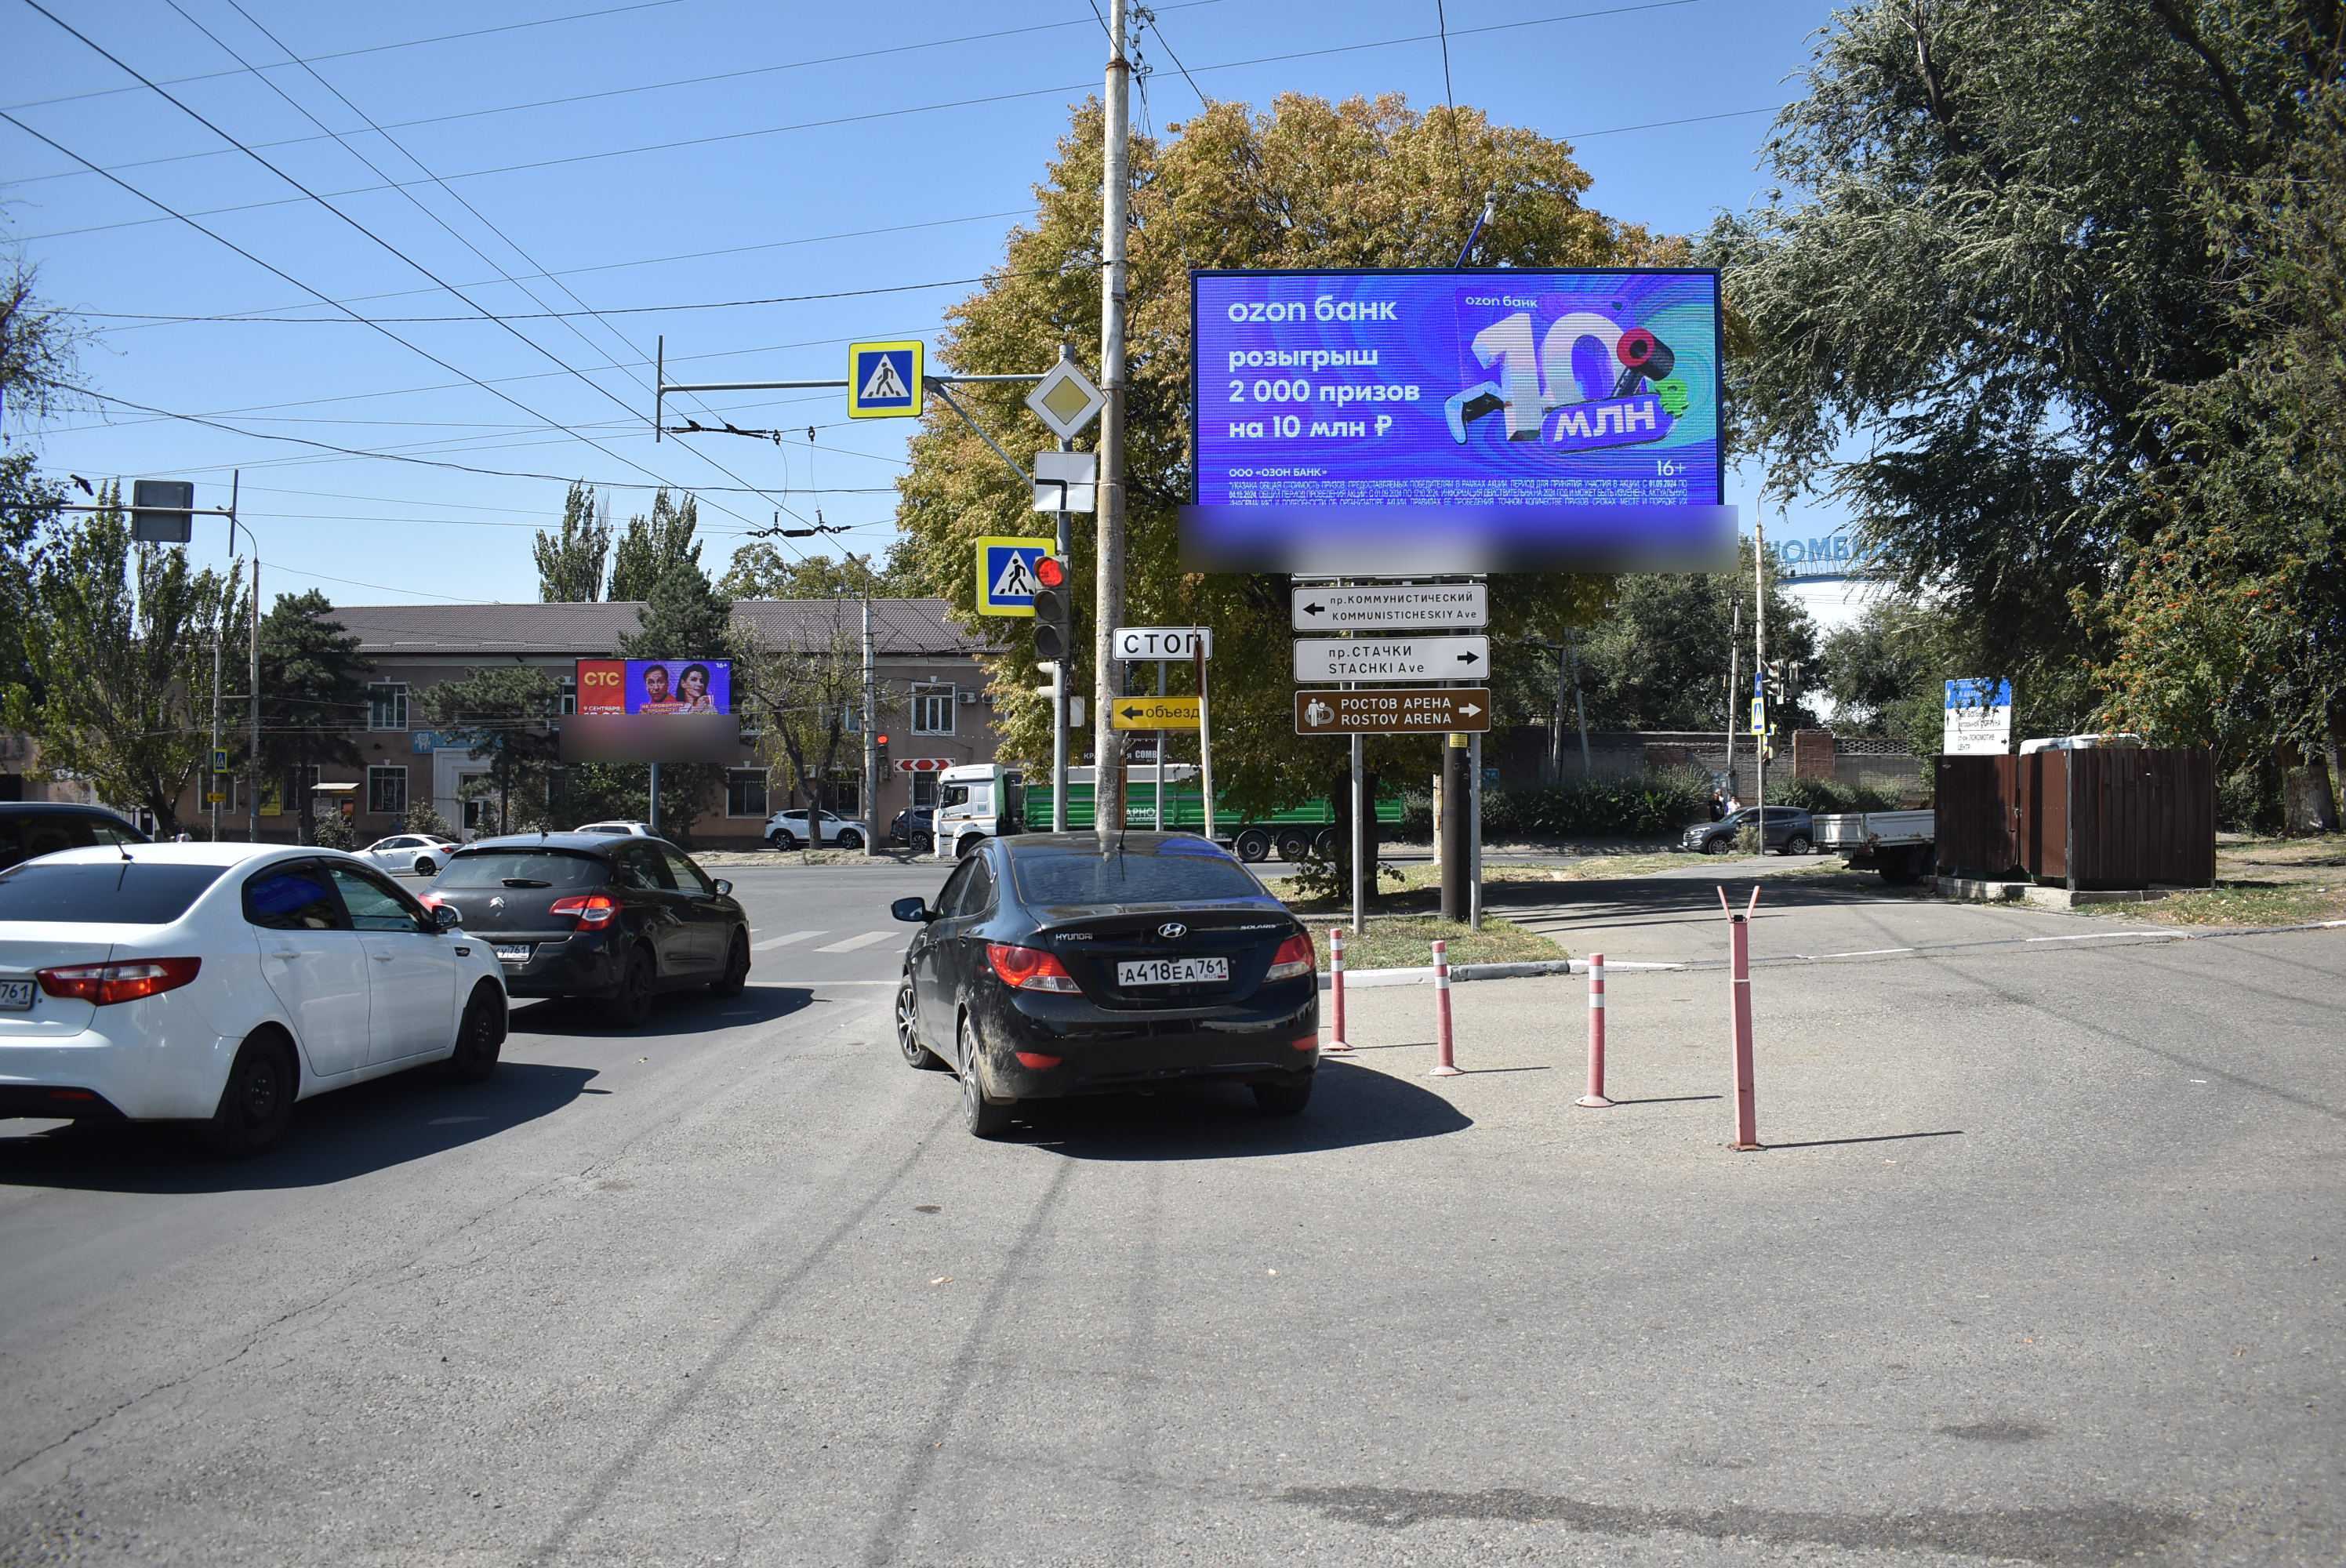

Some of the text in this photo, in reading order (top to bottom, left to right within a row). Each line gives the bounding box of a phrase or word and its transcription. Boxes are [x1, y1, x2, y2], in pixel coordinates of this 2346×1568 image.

[1228, 294, 1398, 322] ozon банк
[1465, 296, 1538, 308] ozon банк
[1229, 350, 1378, 372] розыгрыш
[1471, 313, 1629, 441] 10
[1229, 379, 1420, 407] 2 000 призов
[1229, 423, 1263, 437] на
[1273, 416, 1301, 437] 10
[1309, 421, 1365, 437] млн
[1229, 468, 1327, 477] ООО «ОЗОН БАНК»
[1657, 460, 1686, 477] 16+
[1330, 591, 1473, 604] пр.КОММУНИСТИЧЕСКИЙ
[1332, 610, 1477, 621] KOMMUNISTICHESKIY Ave
[1328, 646, 1412, 659] пр.СТАЧКИ
[1328, 662, 1425, 674] STACHKI Ave
[584, 671, 619, 686] СТС
[1341, 697, 1451, 710] РОСТОВ АРЕНА
[1146, 705, 1200, 720] объезд
[1341, 713, 1452, 725] ROSTOV ARENA
[1197, 960, 1223, 974] 761
[2, 984, 28, 999] 761
